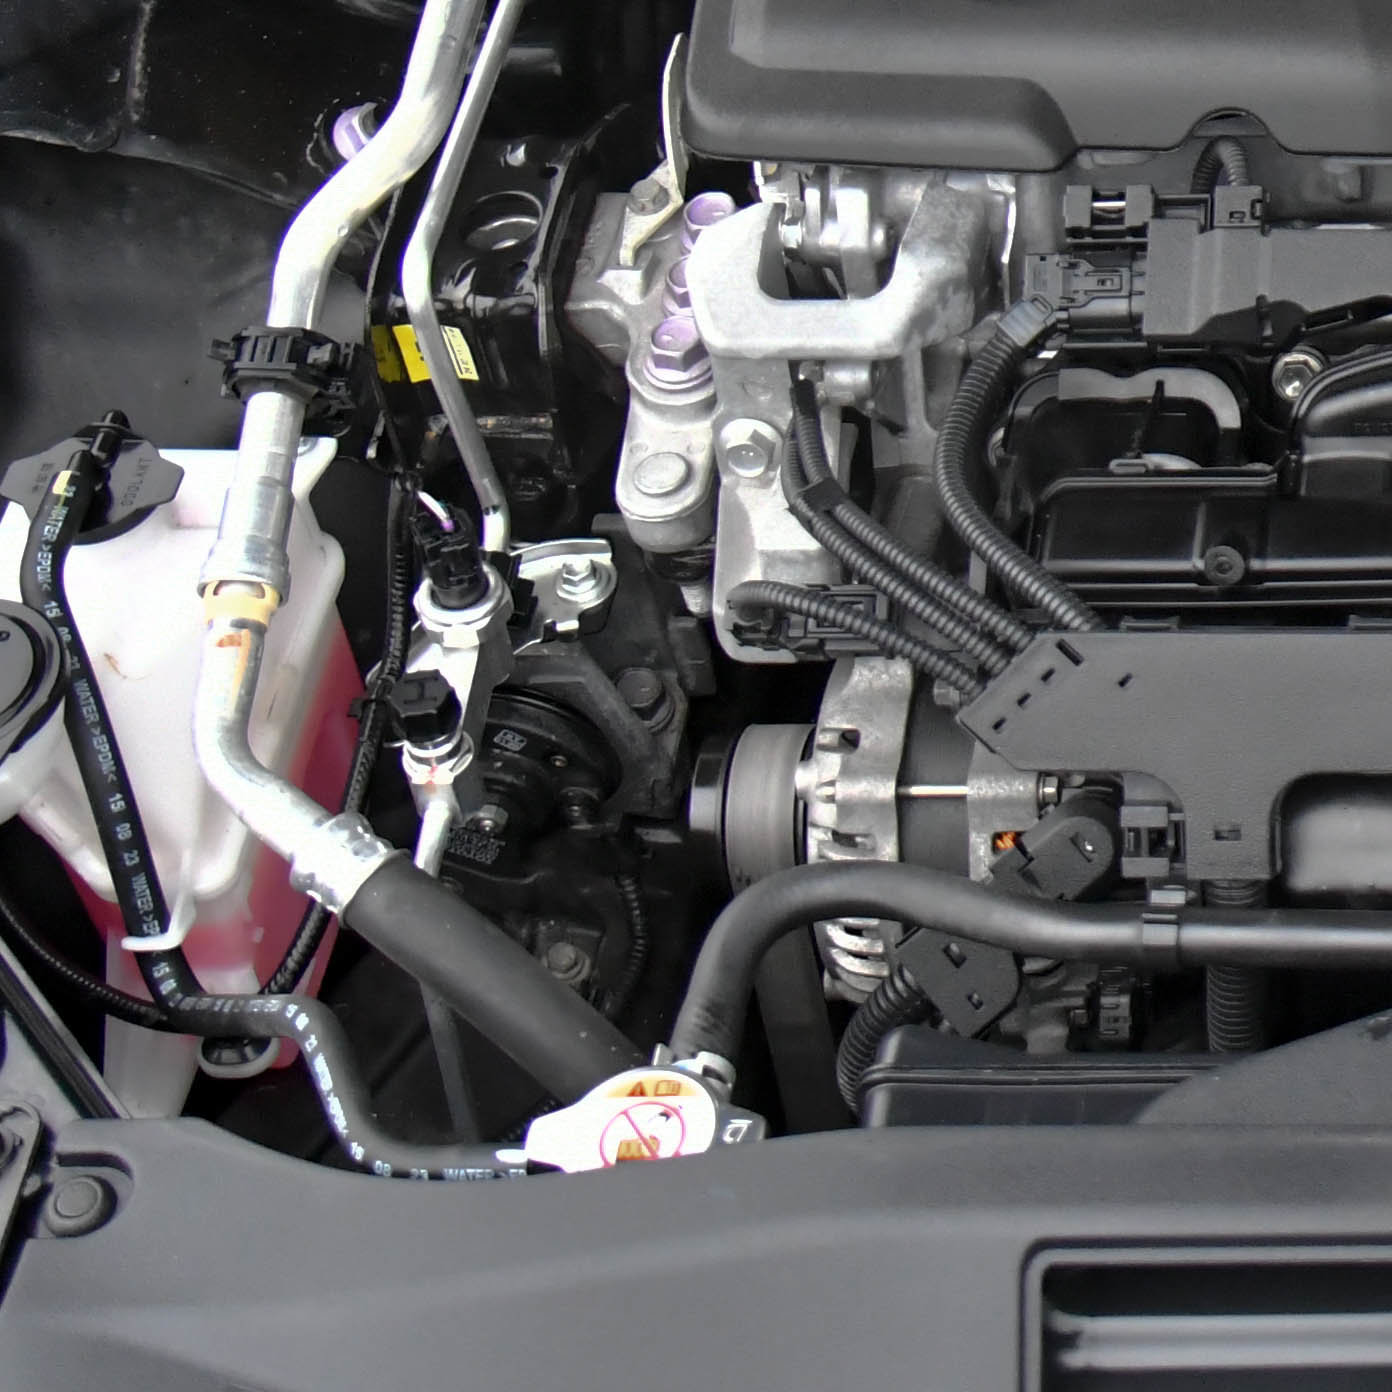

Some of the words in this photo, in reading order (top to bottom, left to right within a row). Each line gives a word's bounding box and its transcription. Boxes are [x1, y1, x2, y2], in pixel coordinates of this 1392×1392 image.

[44, 504, 67, 543] WATER
[75, 679, 99, 724] WATER
[91, 725, 117, 783] >EPDM<
[108, 793, 125, 812] 15
[117, 823, 132, 840] 08
[124, 850, 140, 866] 23
[131, 873, 154, 913] WATER
